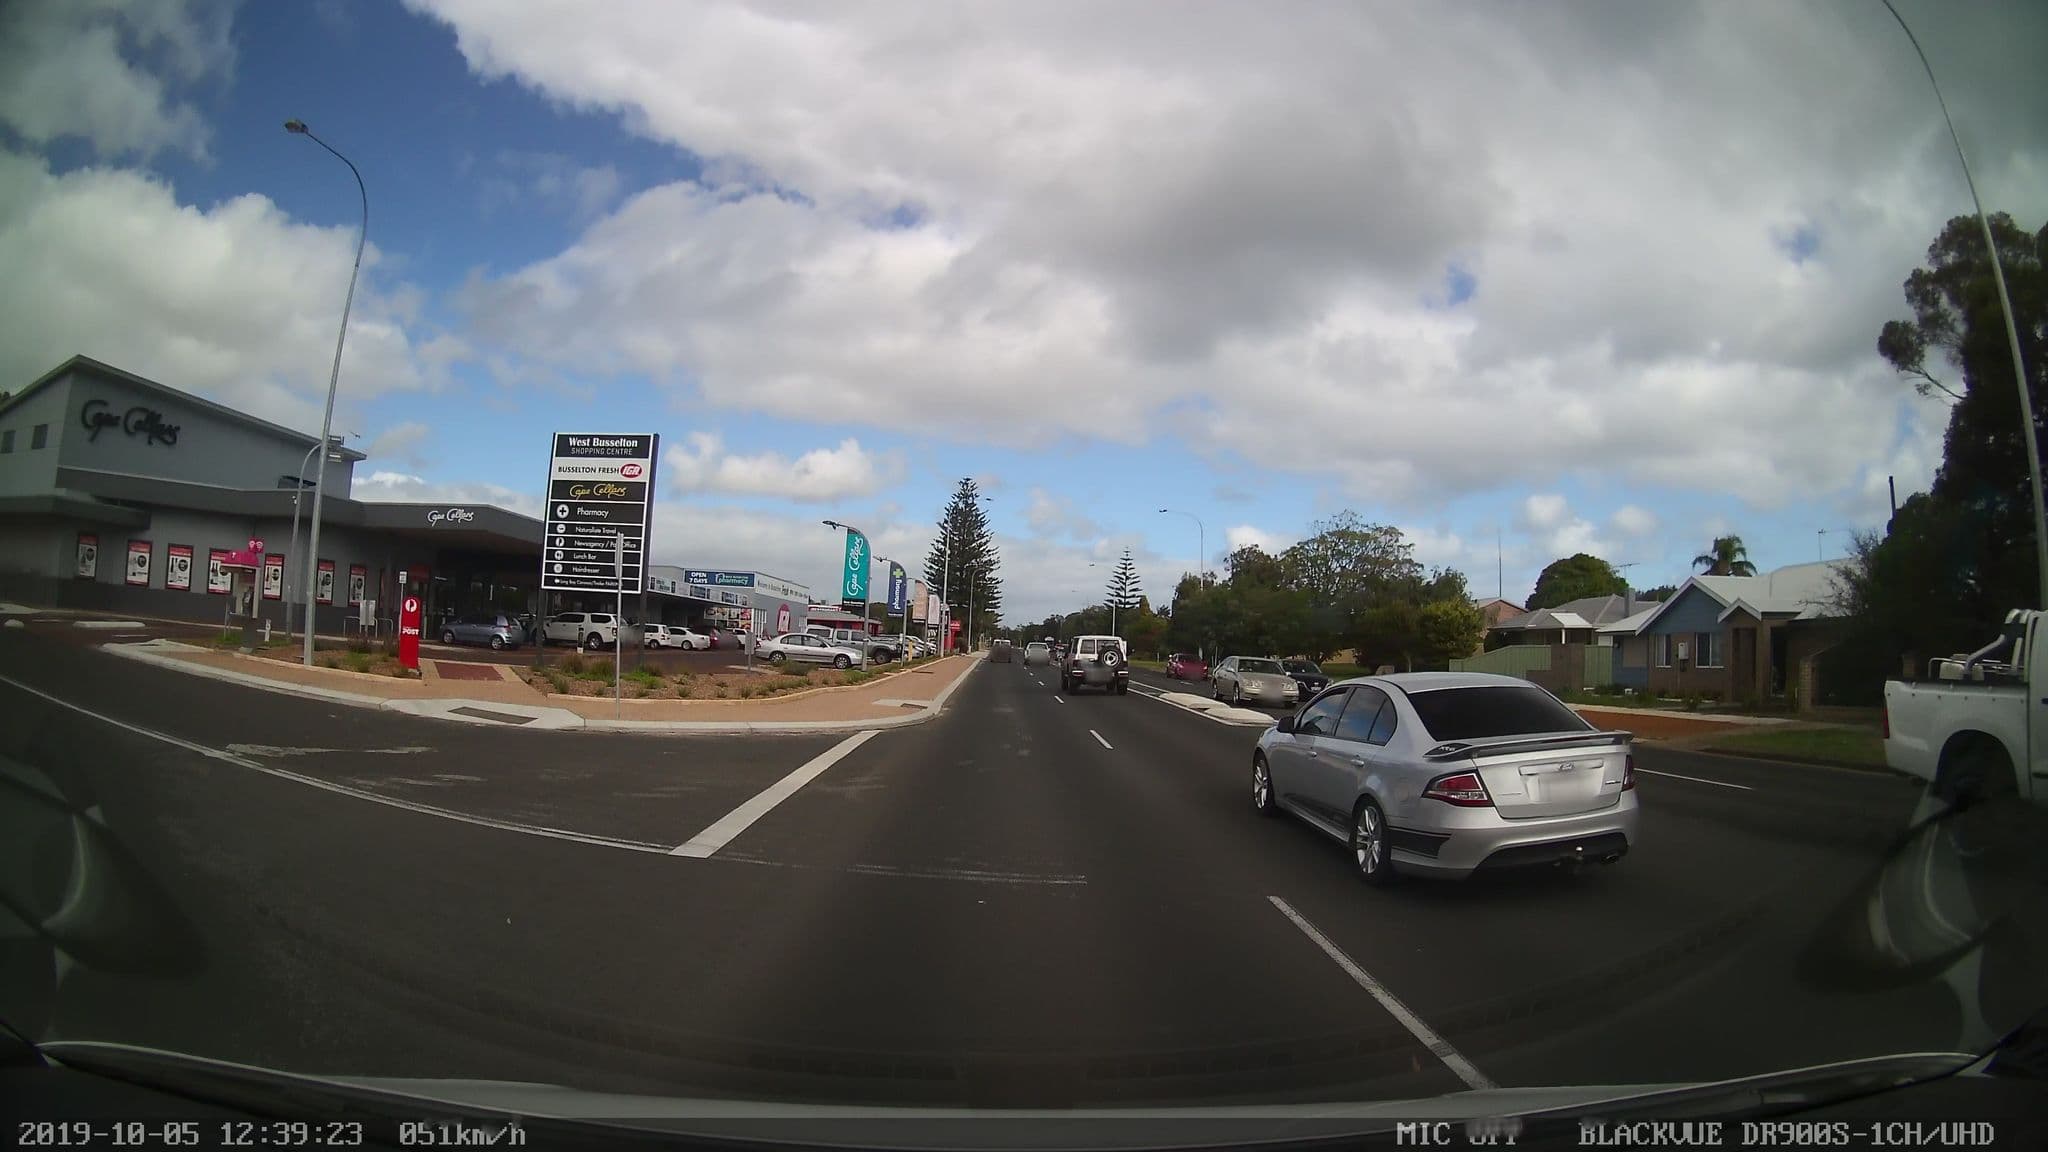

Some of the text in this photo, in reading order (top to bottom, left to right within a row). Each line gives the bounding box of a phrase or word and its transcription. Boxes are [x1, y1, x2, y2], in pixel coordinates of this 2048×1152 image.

[569, 437, 638, 448] West Busselton
[571, 447, 633, 456] SHOPPING CENTRE
[558, 466, 597, 474] BUSSELTON
[622, 465, 640, 475] IGA
[577, 507, 609, 518] Pharmacy
[892, 578, 903, 610] pharmacy
